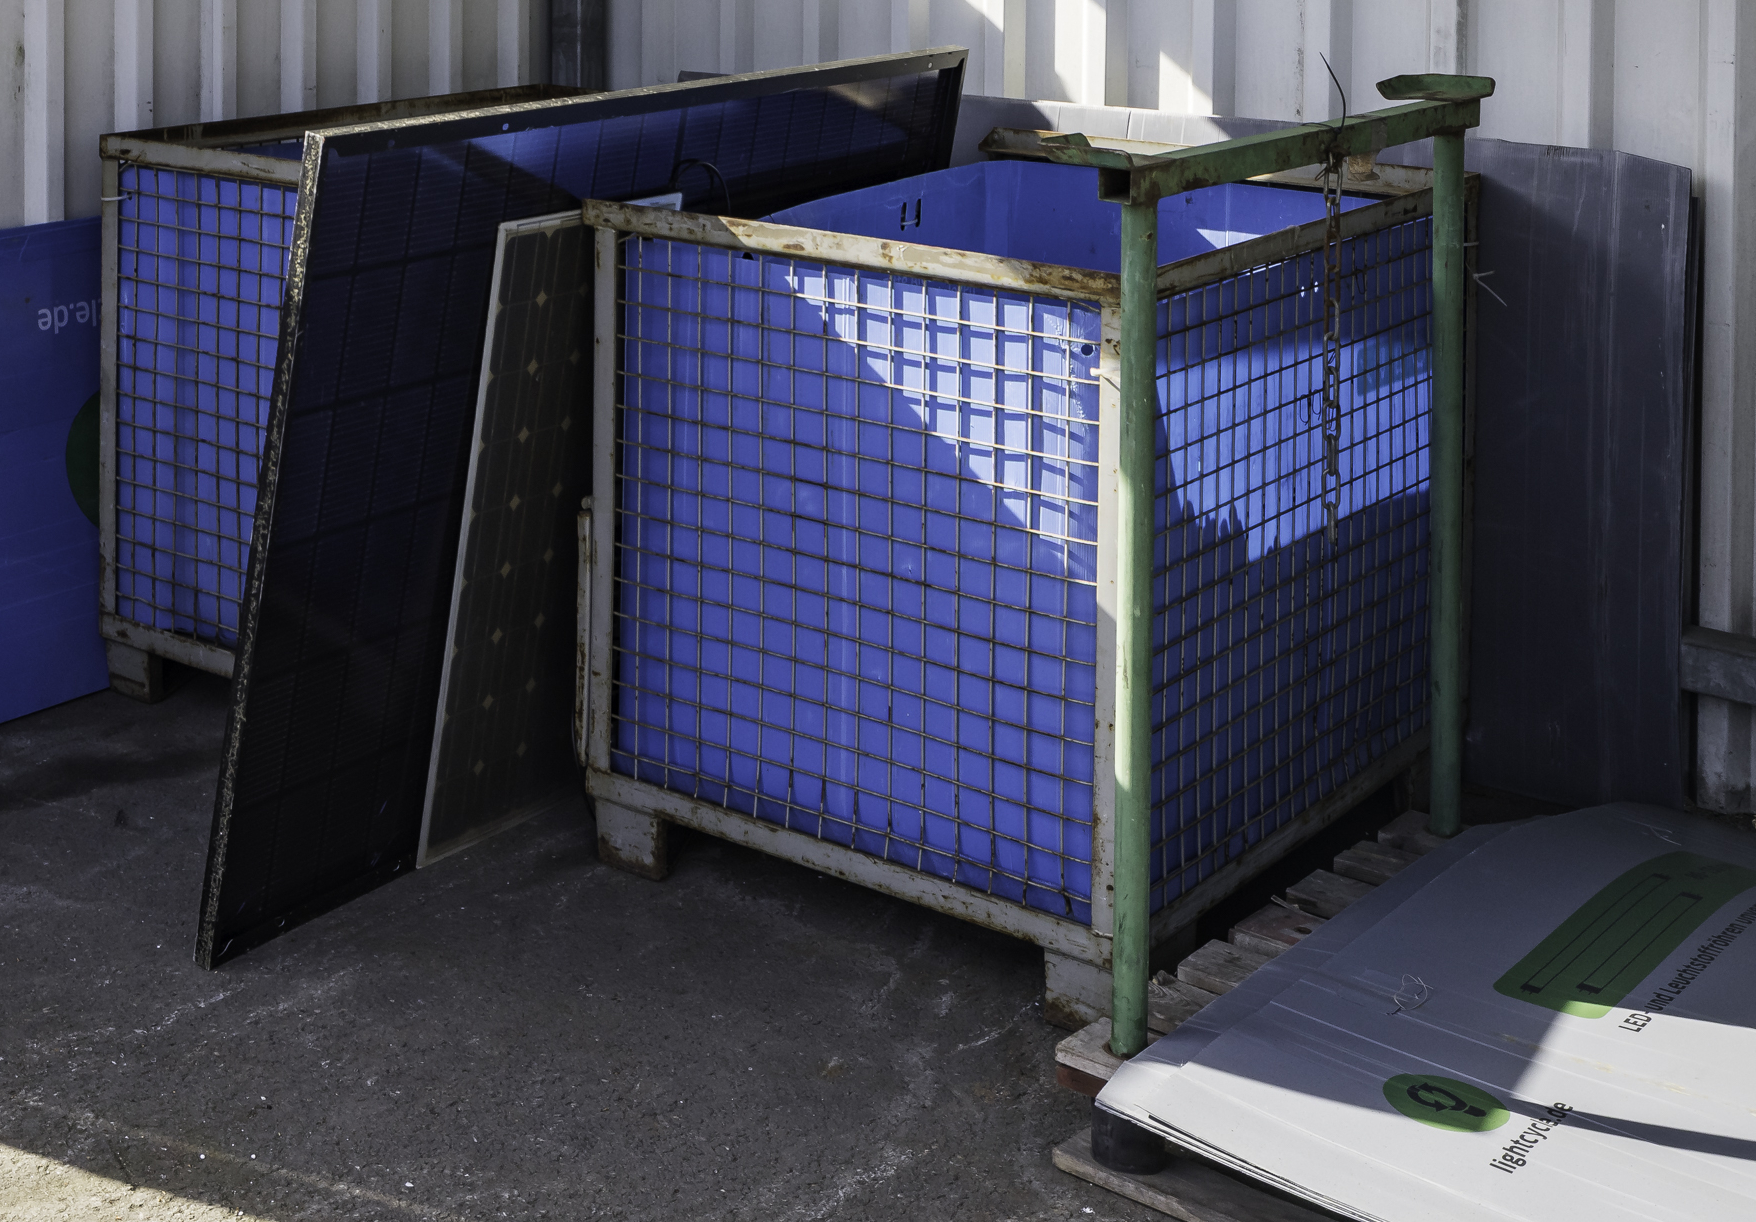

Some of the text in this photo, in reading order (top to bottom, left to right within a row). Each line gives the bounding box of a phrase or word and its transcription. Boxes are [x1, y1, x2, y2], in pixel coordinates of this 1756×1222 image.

[38, 298, 101, 334] le.de
[1618, 1006, 1653, 1033] LED-
[1649, 988, 1676, 1011] und
[1667, 922, 1743, 996] Leuchtstoffröhren
[1488, 1101, 1574, 1175] lightcycle.de
